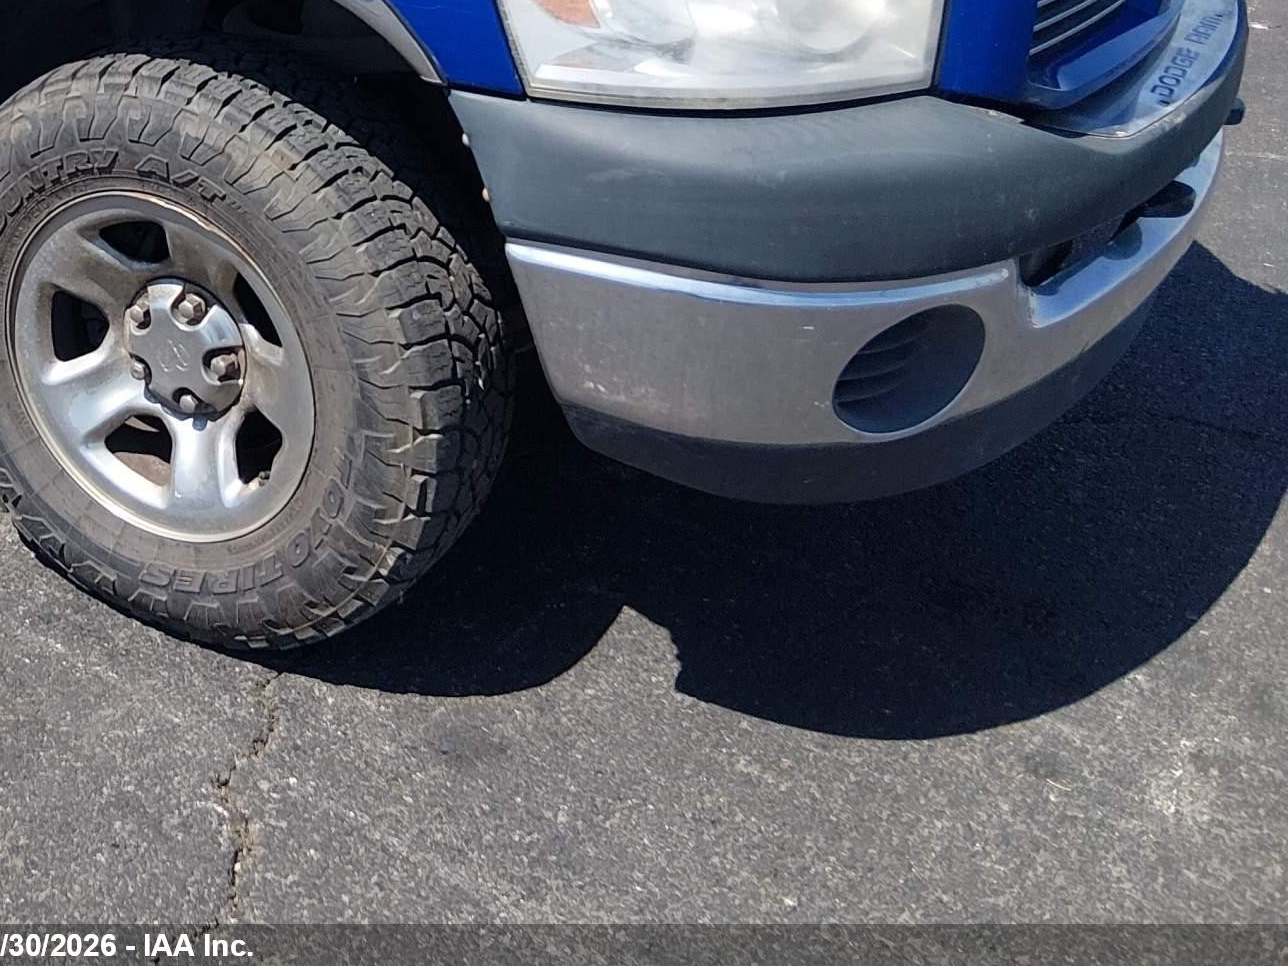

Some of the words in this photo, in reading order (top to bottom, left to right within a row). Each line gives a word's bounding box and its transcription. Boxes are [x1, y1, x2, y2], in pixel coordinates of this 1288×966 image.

[1150, 46, 1200, 99] DODGE
[1183, 13, 1223, 46] RAM
[139, 553, 284, 595] TIRES
